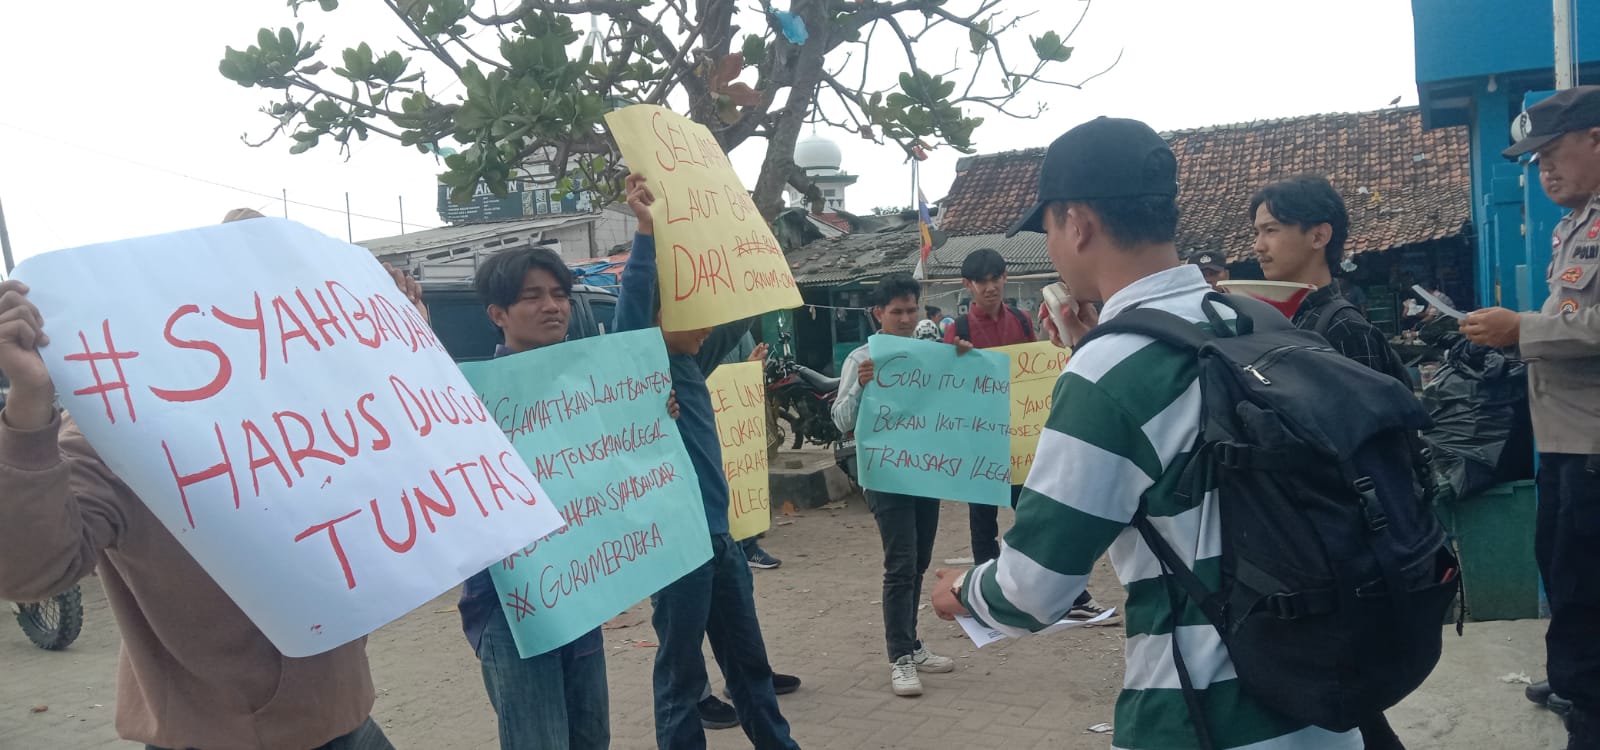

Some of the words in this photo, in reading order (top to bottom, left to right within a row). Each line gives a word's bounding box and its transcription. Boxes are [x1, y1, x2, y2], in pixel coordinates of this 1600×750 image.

[659, 180, 719, 225] LAUT
[673, 244, 736, 301] DARI
[876, 354, 932, 388] GURU
[938, 374, 965, 390] ITU
[716, 416, 765, 448] LOKASI
[873, 405, 926, 432] BUKAN
[161, 392, 391, 529] HARUS
[864, 445, 962, 477] TRANSAKSI
[295, 450, 537, 590] TUNTAS
